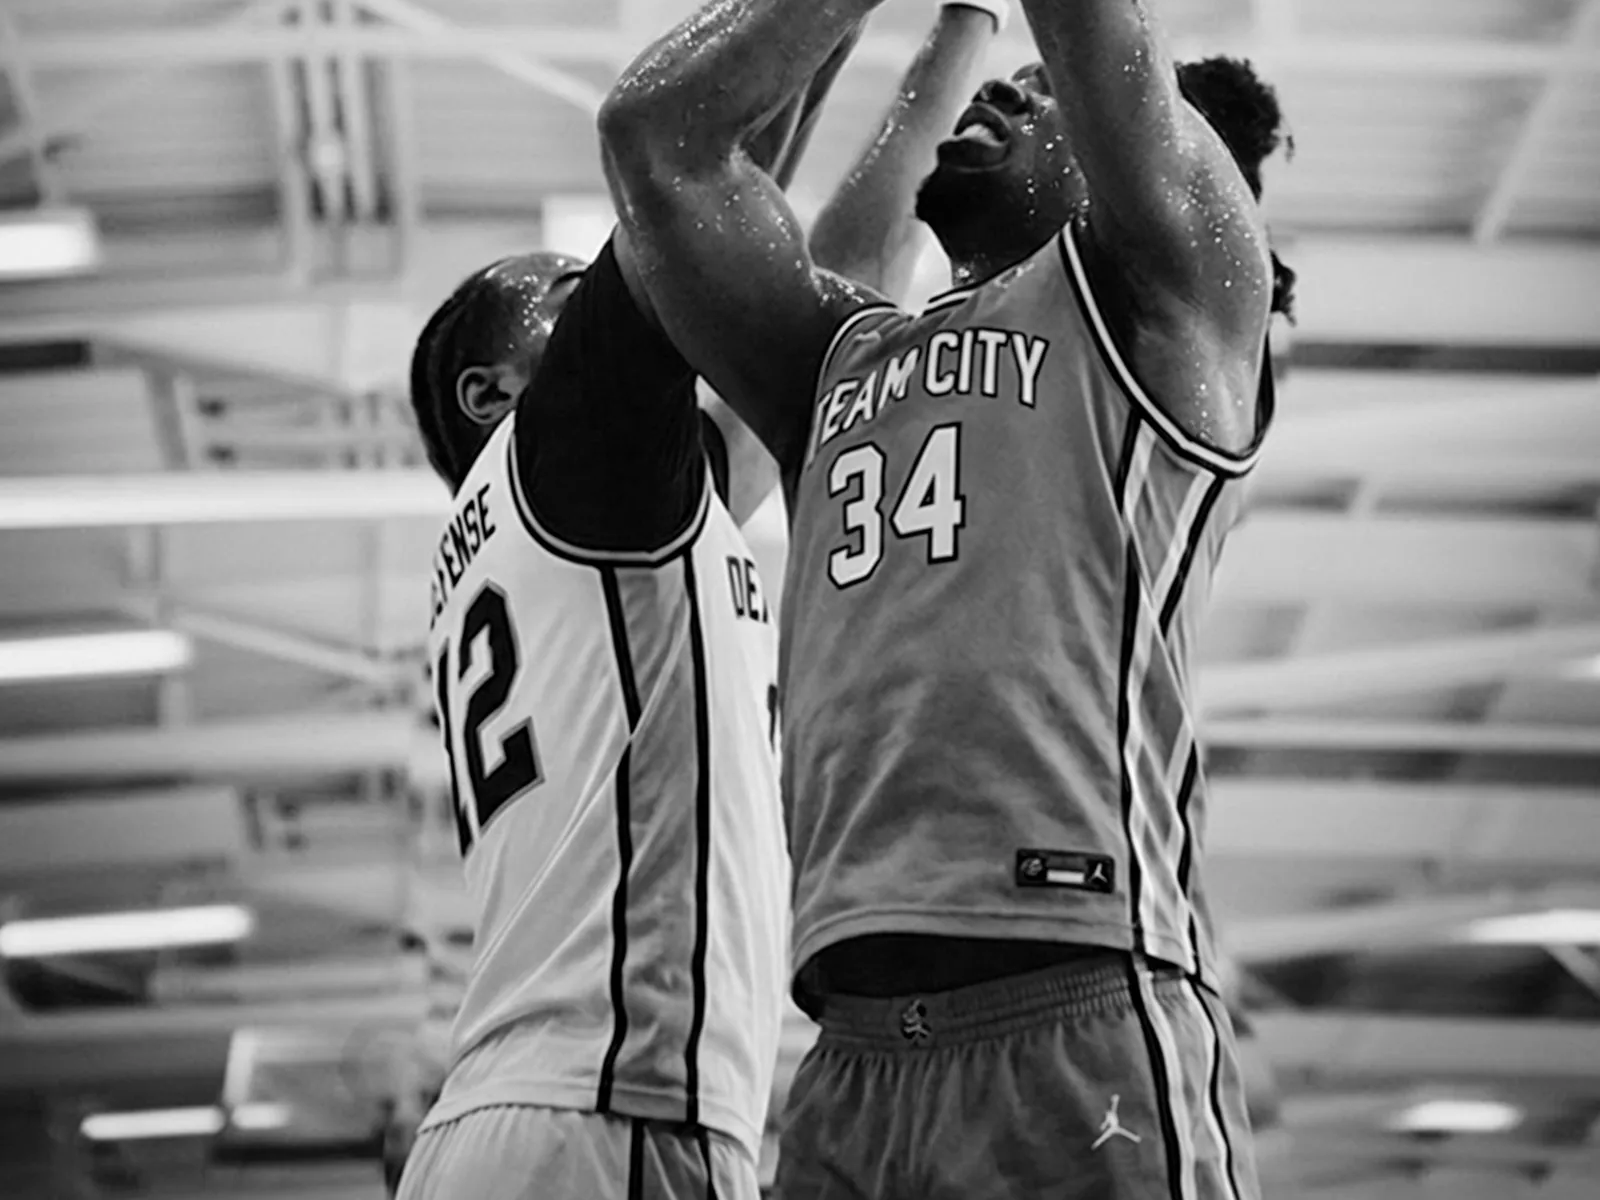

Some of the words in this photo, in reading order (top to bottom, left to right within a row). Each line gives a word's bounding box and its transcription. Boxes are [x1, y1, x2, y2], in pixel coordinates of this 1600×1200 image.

[925, 327, 1049, 409] CITY
[828, 421, 966, 590] 34
[726, 556, 769, 624] DE
